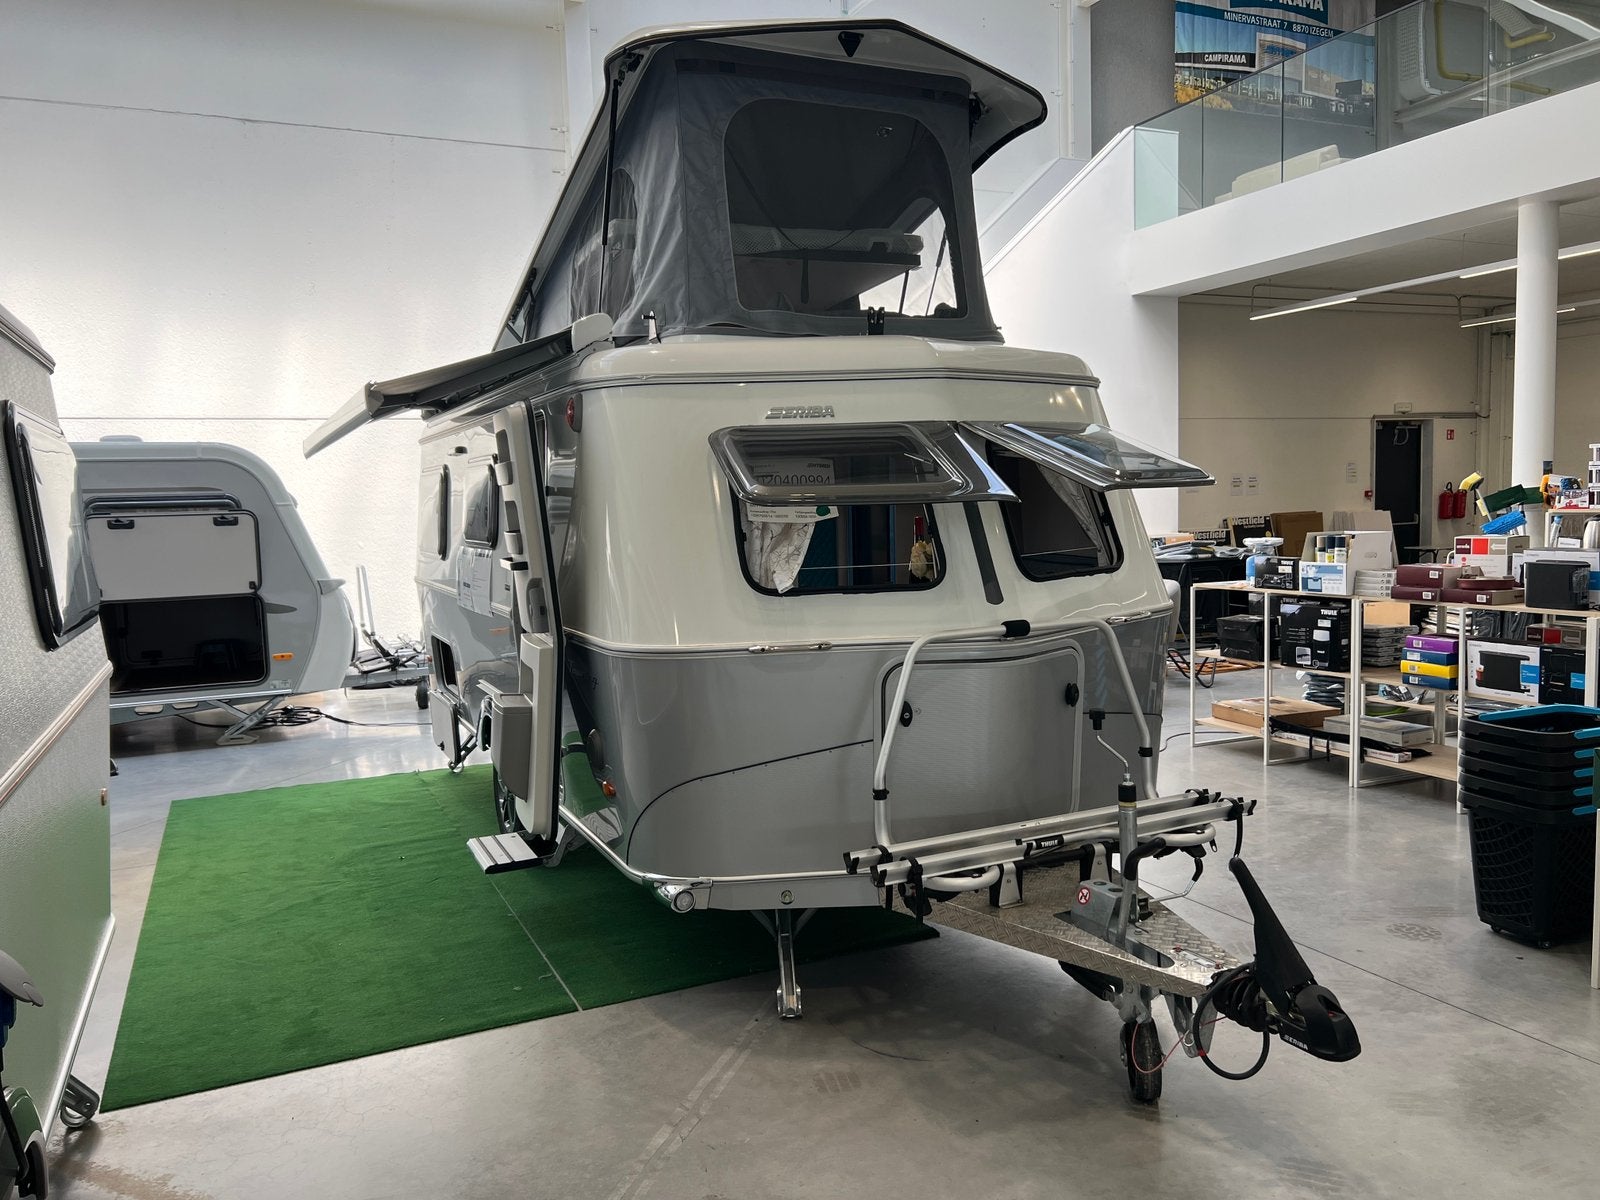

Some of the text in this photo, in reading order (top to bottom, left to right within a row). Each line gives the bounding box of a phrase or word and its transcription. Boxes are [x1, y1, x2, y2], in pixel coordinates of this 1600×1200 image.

[1224, 11, 1334, 38] MINERVASTRAAT 7 8870 IZEGEM
[1204, 54, 1247, 64] CAMPIRAMA
[1232, 515, 1265, 526] Westfield
[1041, 839, 1059, 848] THULE
